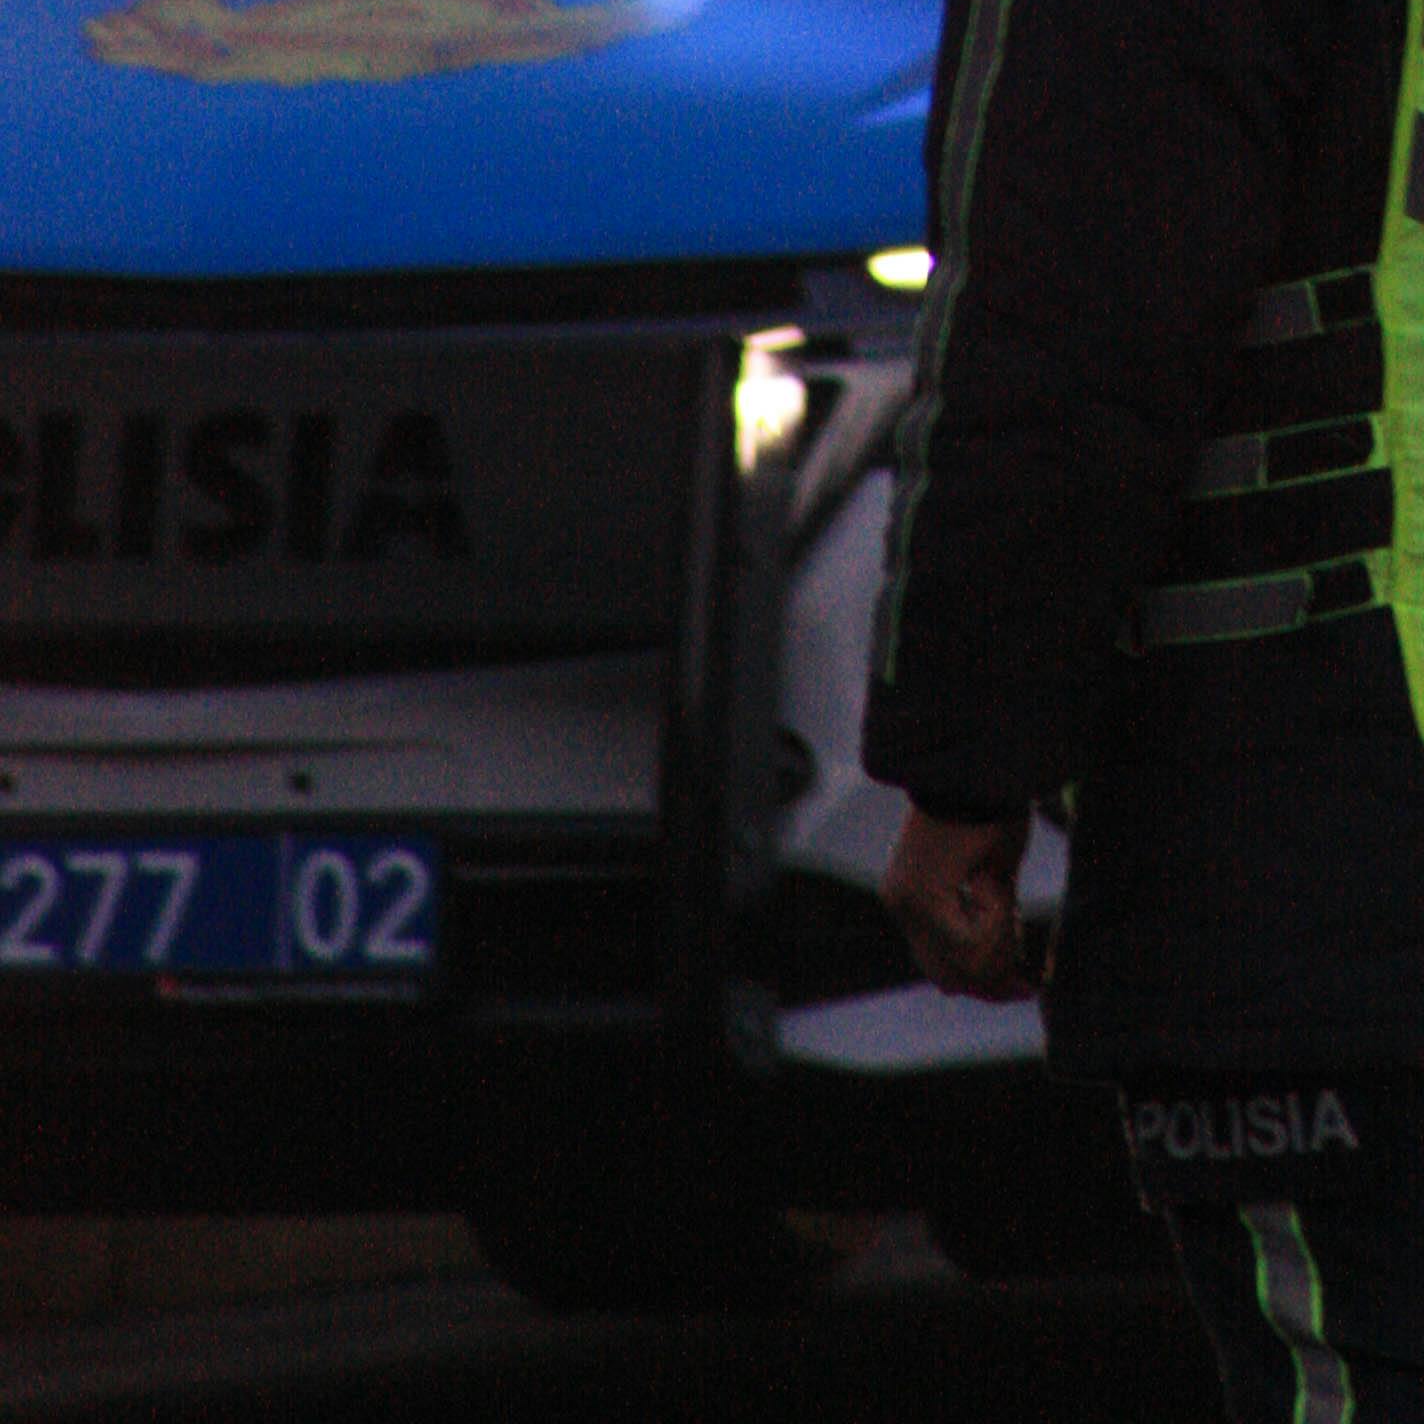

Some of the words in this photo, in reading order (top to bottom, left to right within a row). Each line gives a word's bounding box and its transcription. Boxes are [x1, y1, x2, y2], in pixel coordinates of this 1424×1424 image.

[0, 409, 472, 562] LISIA
[0, 849, 200, 964] 277
[296, 848, 434, 964] 02
[1133, 1088, 1360, 1160] POLISIA
